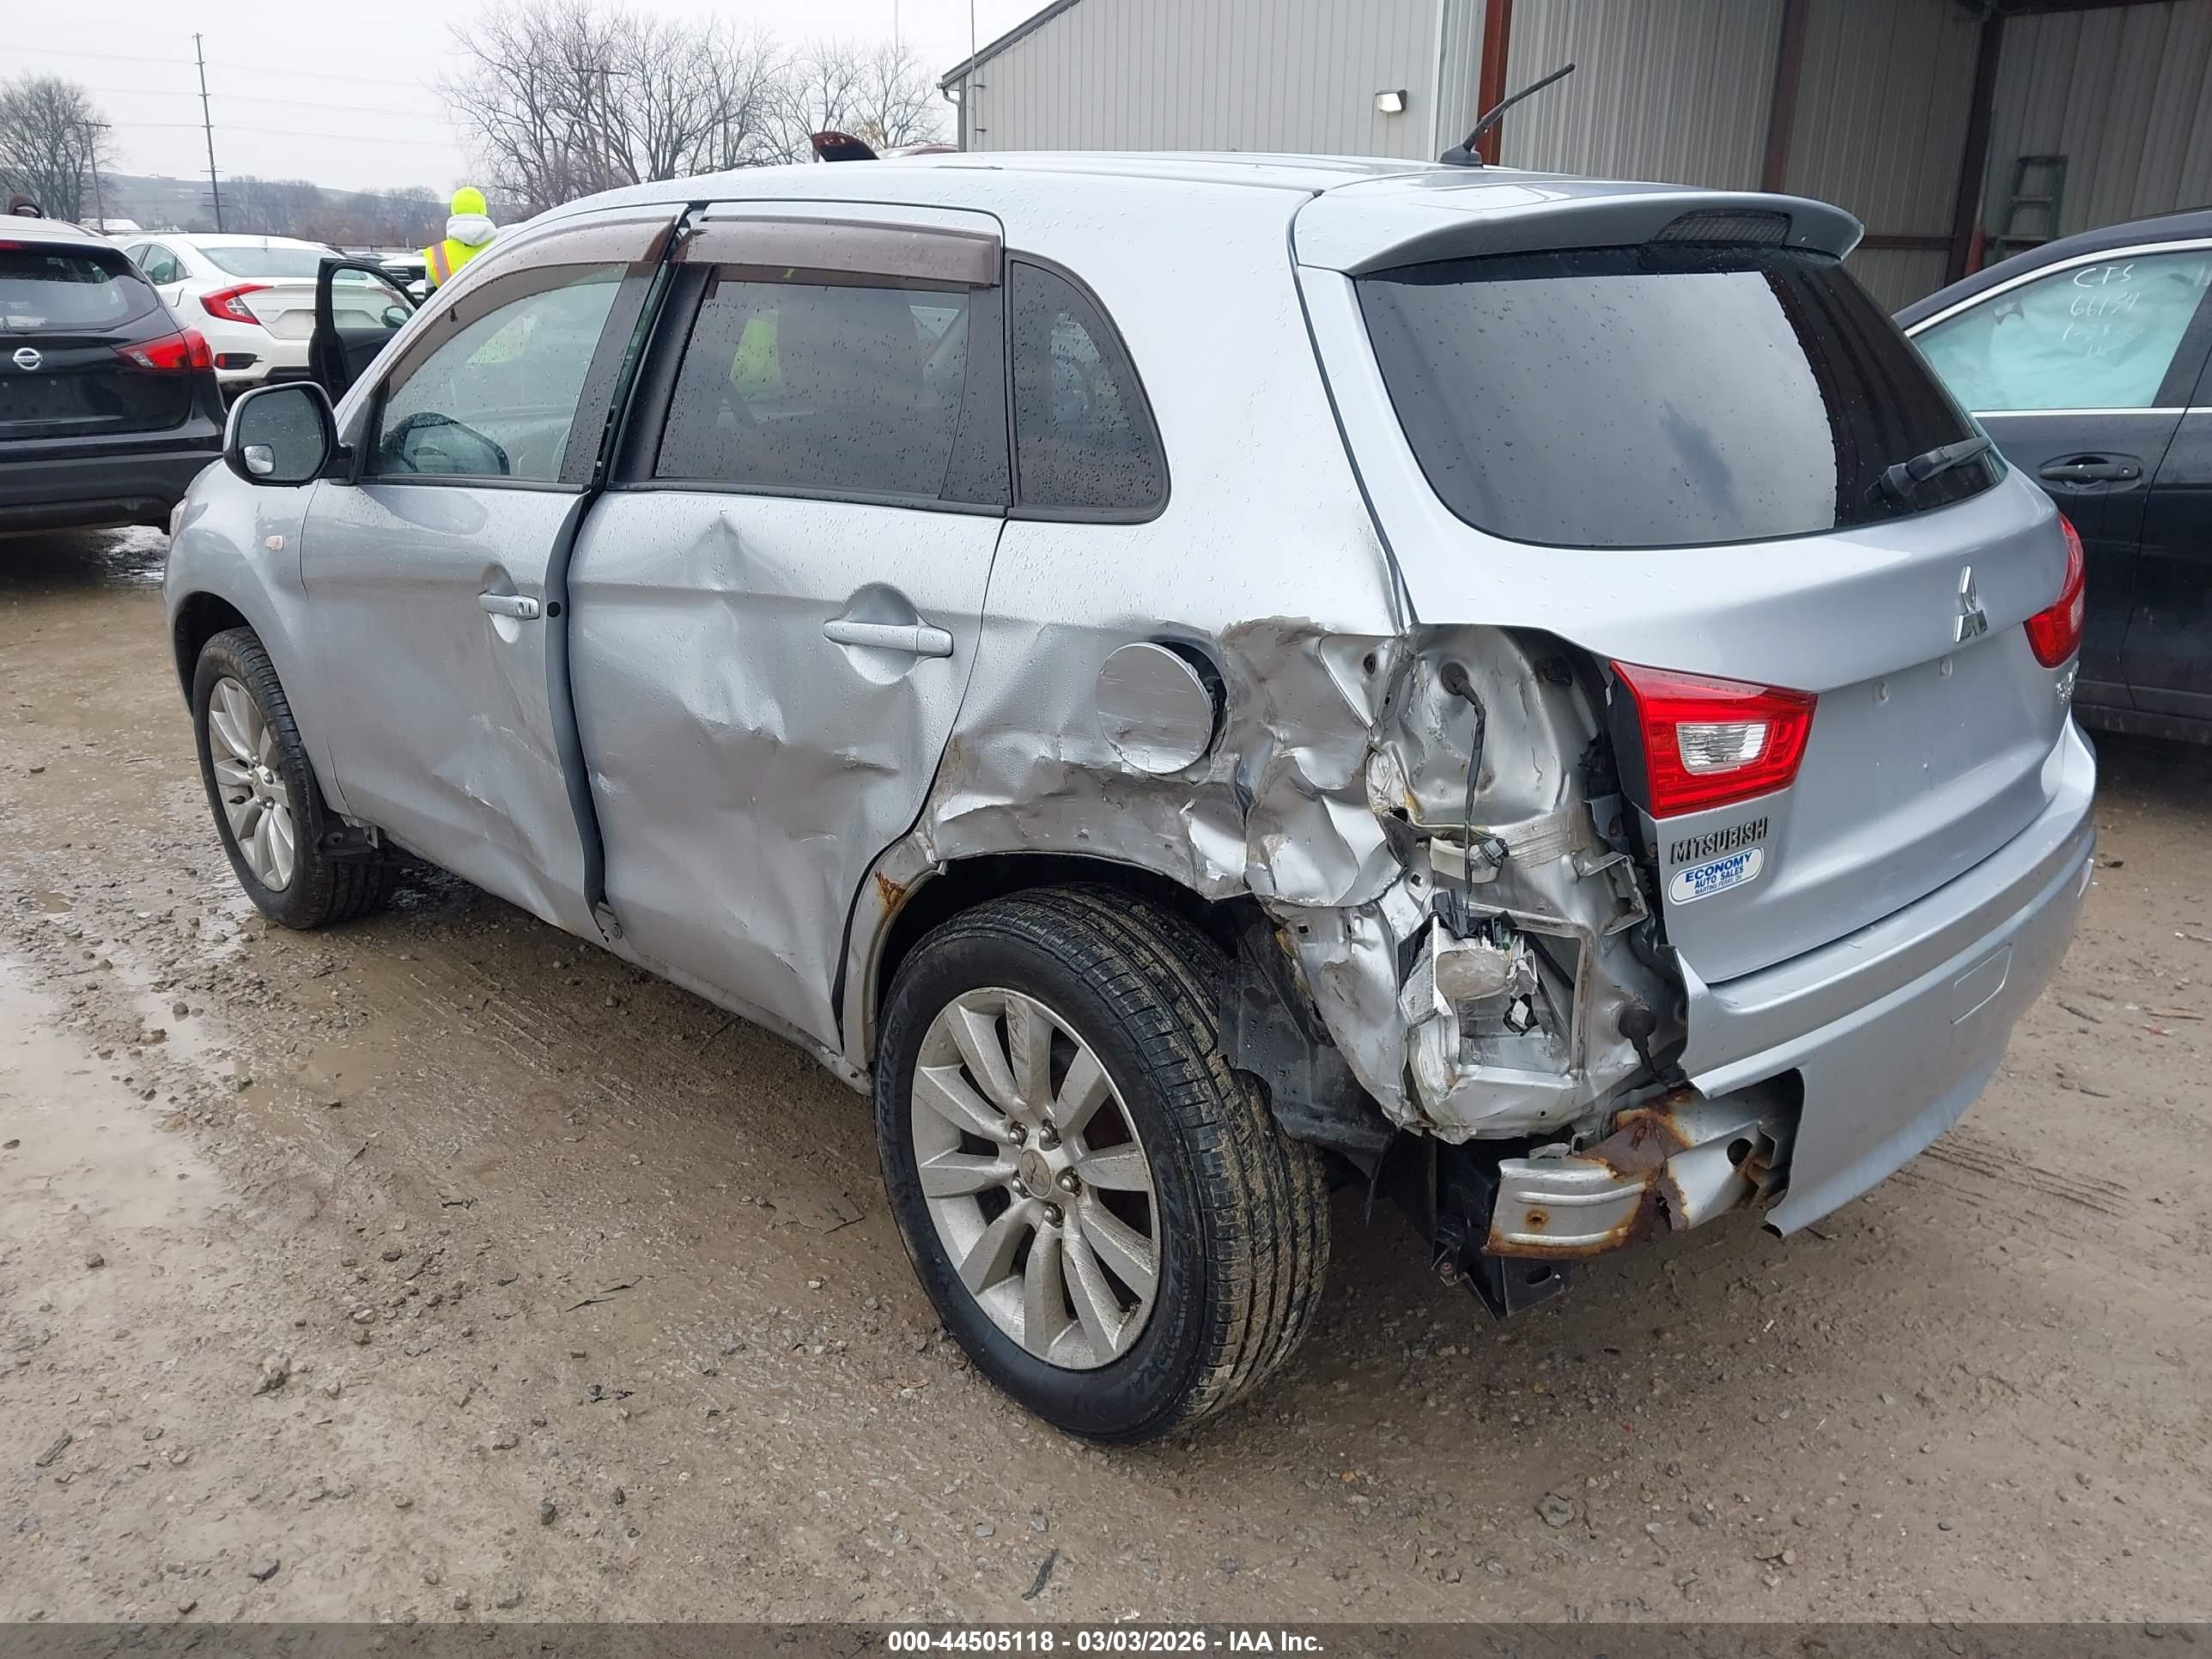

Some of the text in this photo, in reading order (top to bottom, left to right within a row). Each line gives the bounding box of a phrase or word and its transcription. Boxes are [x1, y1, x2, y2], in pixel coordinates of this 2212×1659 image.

[2074, 264, 2135, 288] CTS
[1670, 817, 1770, 865] MITSUBISHI
[1685, 852, 1753, 883] ECONOMY
[1694, 865, 1744, 889] AUTO SALES
[1694, 883, 1717, 895] MARTINS
